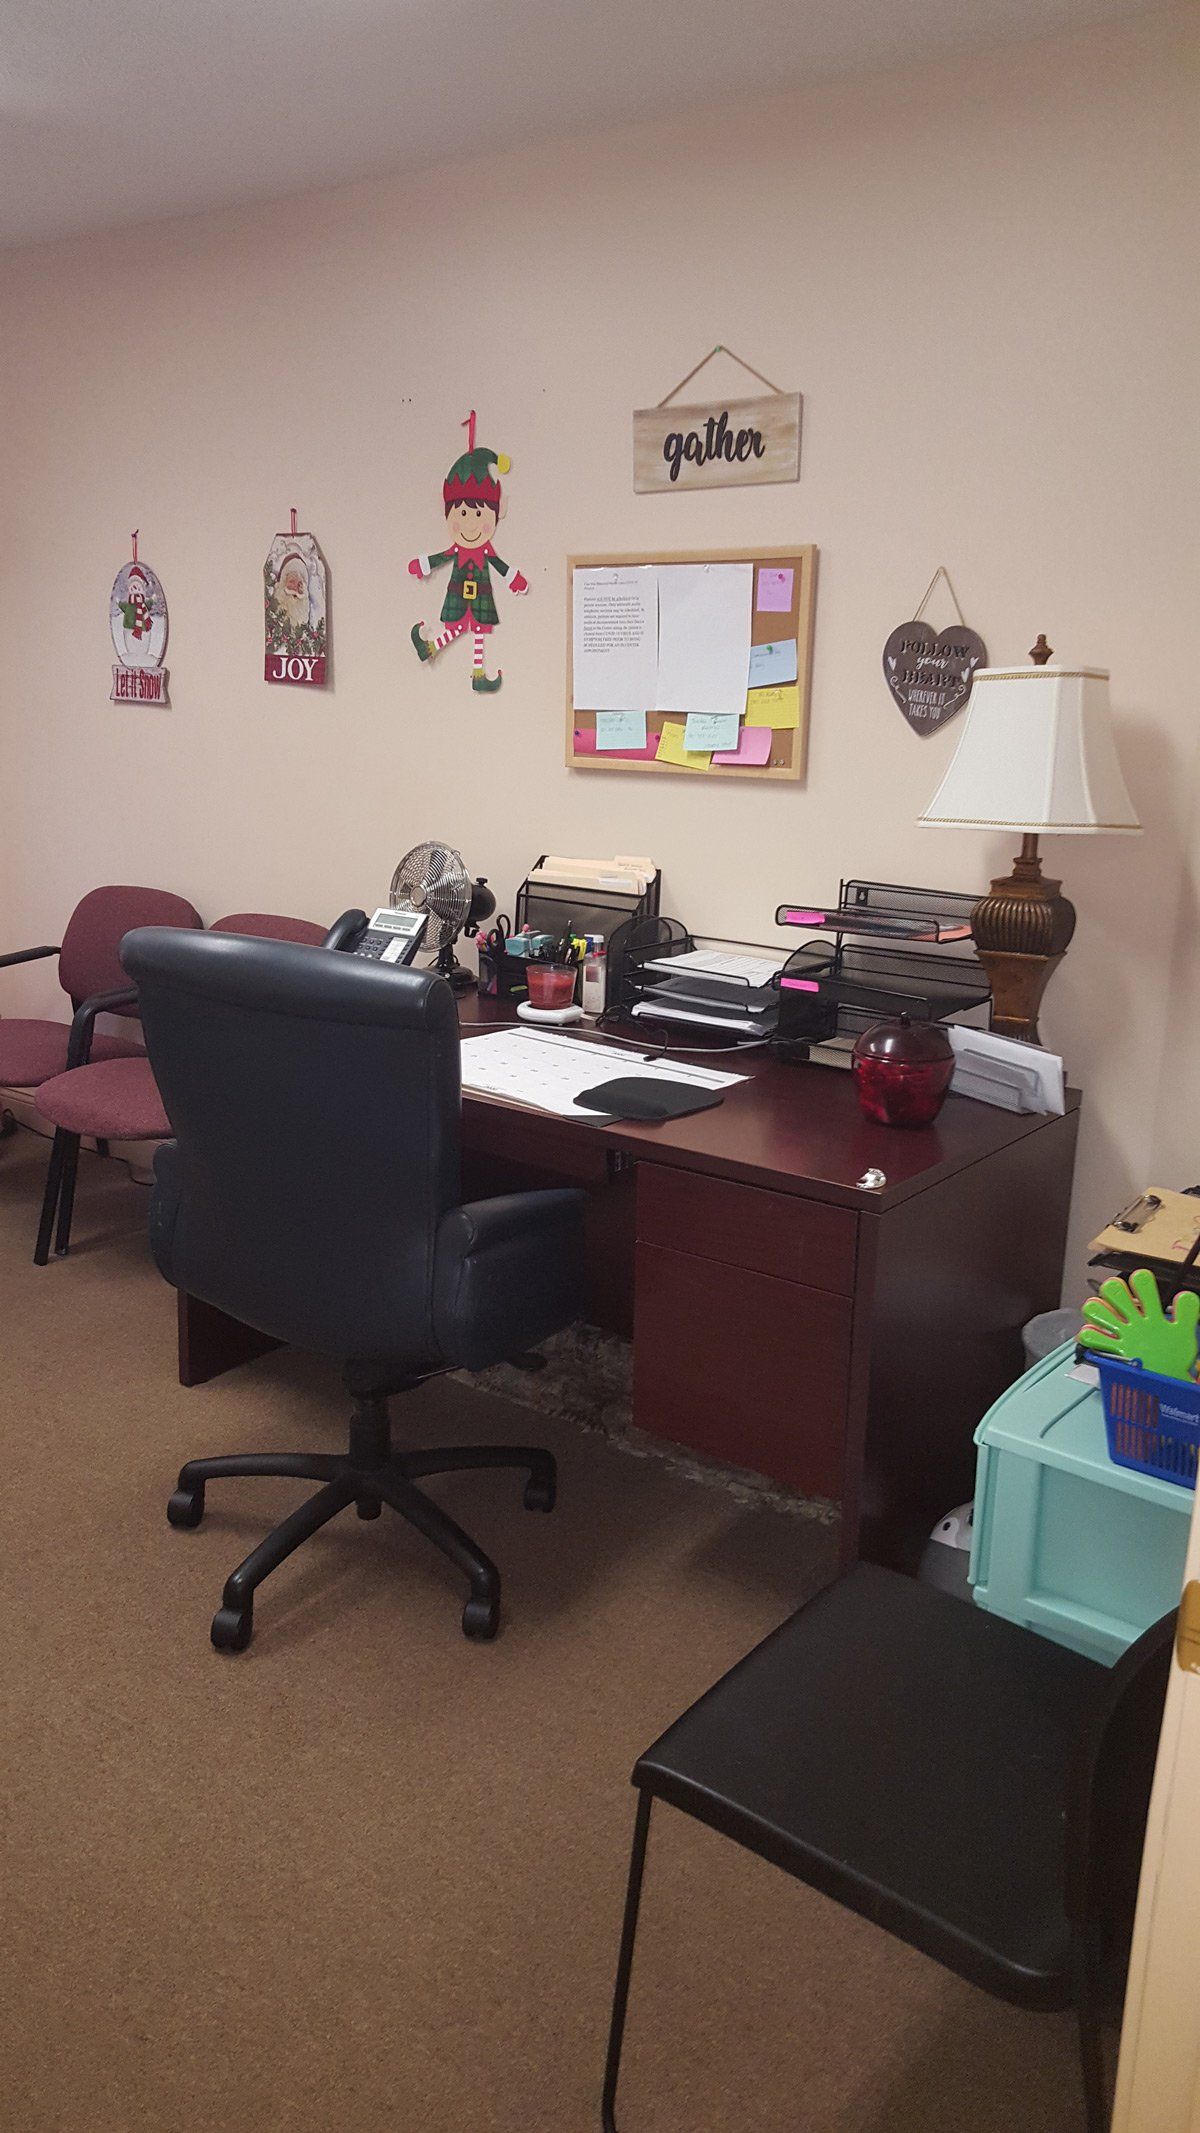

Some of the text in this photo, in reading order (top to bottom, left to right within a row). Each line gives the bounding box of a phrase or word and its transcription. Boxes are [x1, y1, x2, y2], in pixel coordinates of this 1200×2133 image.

[663, 411, 766, 482] gather
[901, 640, 970, 660] FOLLOW
[272, 657, 319, 681] JOY
[916, 656, 949, 670] your
[115, 667, 161, 700] Let it Snow
[903, 670, 960, 690] HEART
[908, 689, 947, 706] WHEREVER IT
[908, 703, 942, 720] TAKES YOU
[1159, 1403, 1199, 1424] Walmart
